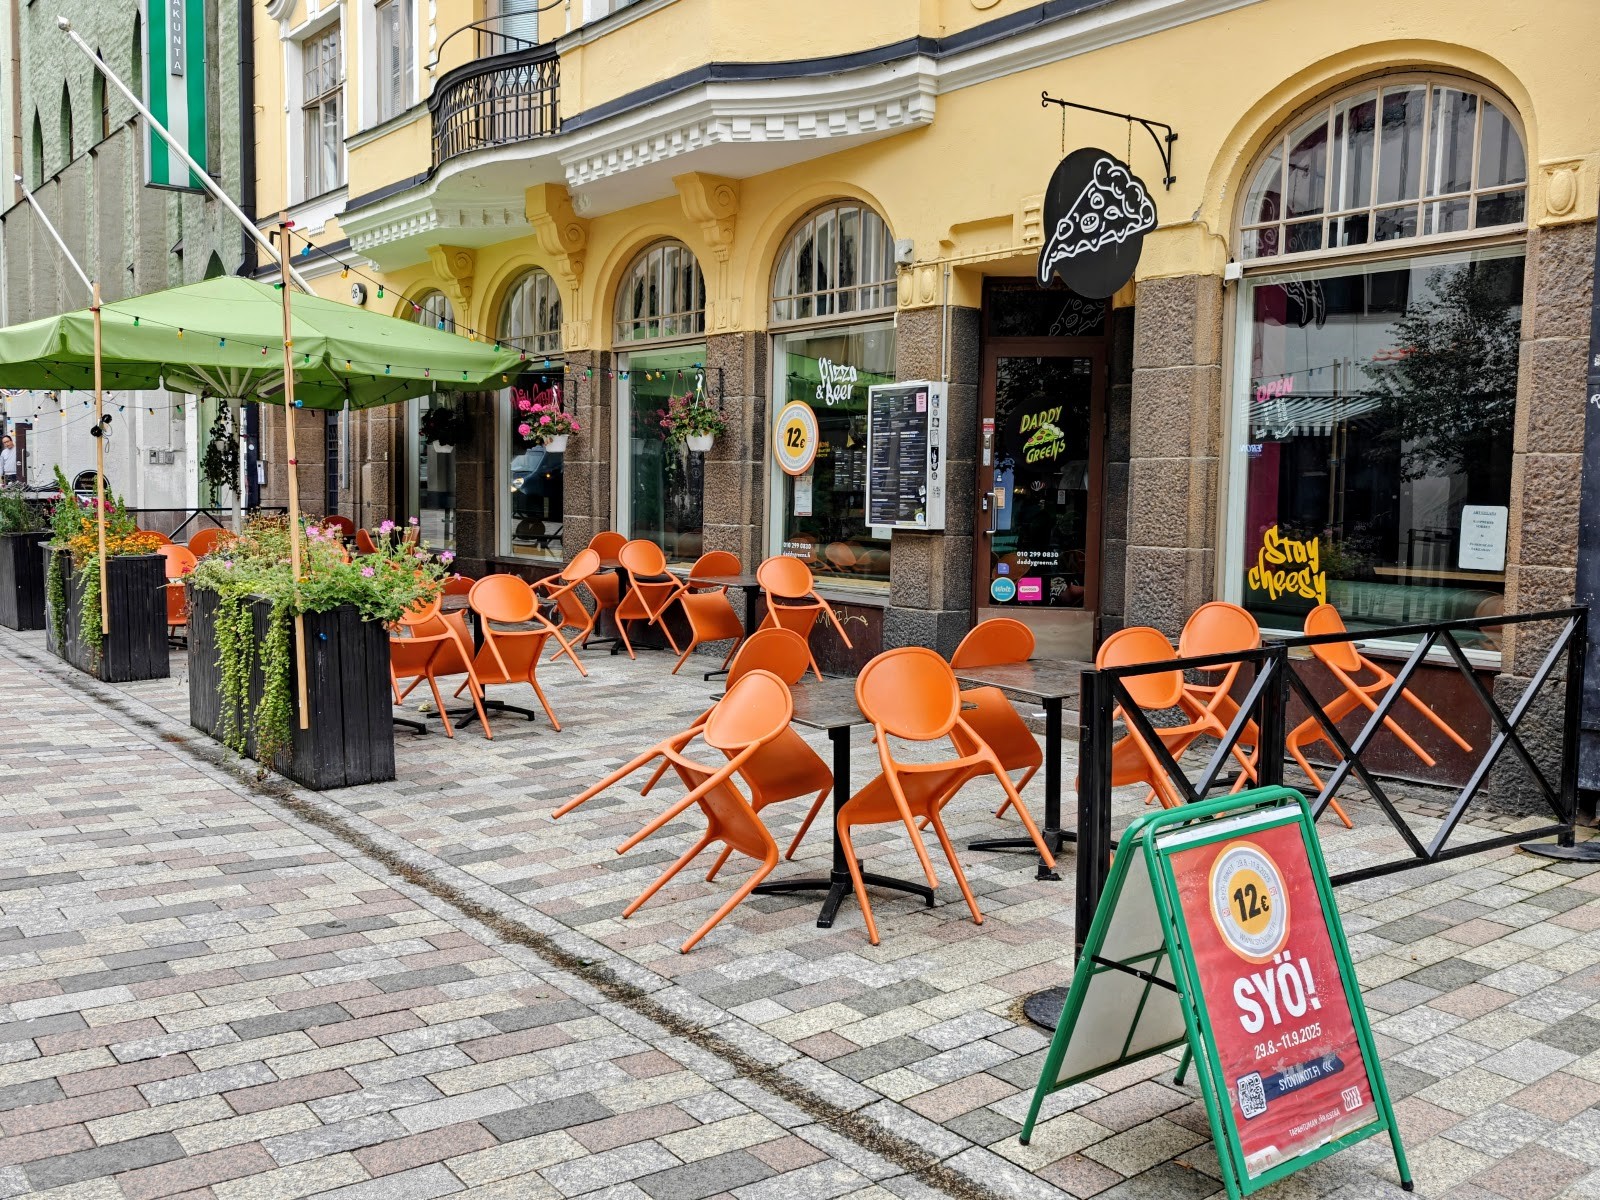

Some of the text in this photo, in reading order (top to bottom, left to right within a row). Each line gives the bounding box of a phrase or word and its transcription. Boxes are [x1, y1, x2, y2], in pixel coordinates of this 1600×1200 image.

[818, 357, 857, 388] Pizza
[816, 384, 824, 399] &
[826, 376, 854, 406] Beer
[1256, 376, 1294, 403] OPEN
[1019, 406, 1062, 434] DADDY
[786, 427, 806, 448] 12€
[1026, 439, 1066, 464] GREENS
[1264, 524, 1318, 574] Stay
[1248, 547, 1326, 606] cheesy
[1234, 883, 1270, 922] 12€
[1233, 950, 1322, 1034] SYÖ!
[1254, 1022, 1322, 1060] 29.8.-11.9.2025
[1278, 1065, 1320, 1091] SYÖVIIKOT.FI
